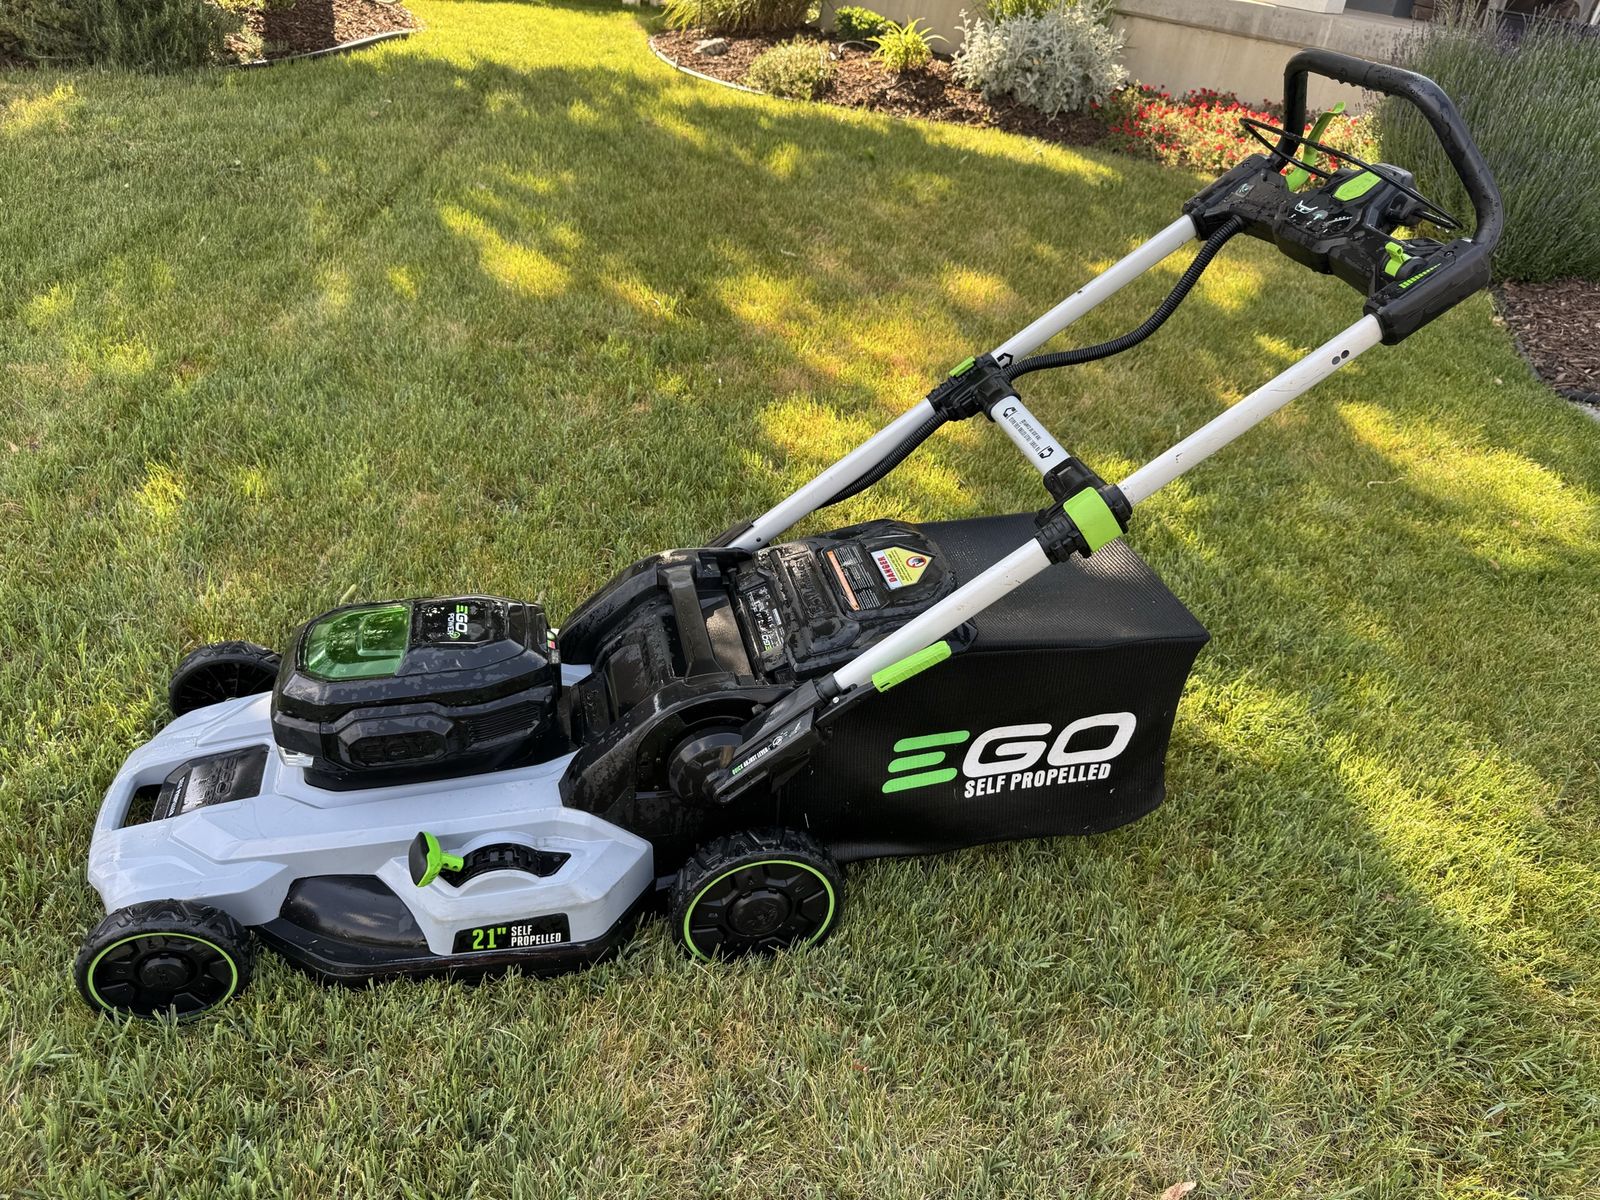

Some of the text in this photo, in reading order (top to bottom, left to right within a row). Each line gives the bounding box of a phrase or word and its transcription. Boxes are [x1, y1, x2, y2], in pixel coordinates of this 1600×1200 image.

[877, 556, 898, 583] DANGER
[455, 604, 469, 633] EGO
[881, 711, 1137, 794] EGO
[964, 763, 1112, 799] SELF PROPELLED
[472, 926, 507, 950] 21"
[510, 924, 533, 937] SELF
[510, 932, 562, 947] PROPELLED
